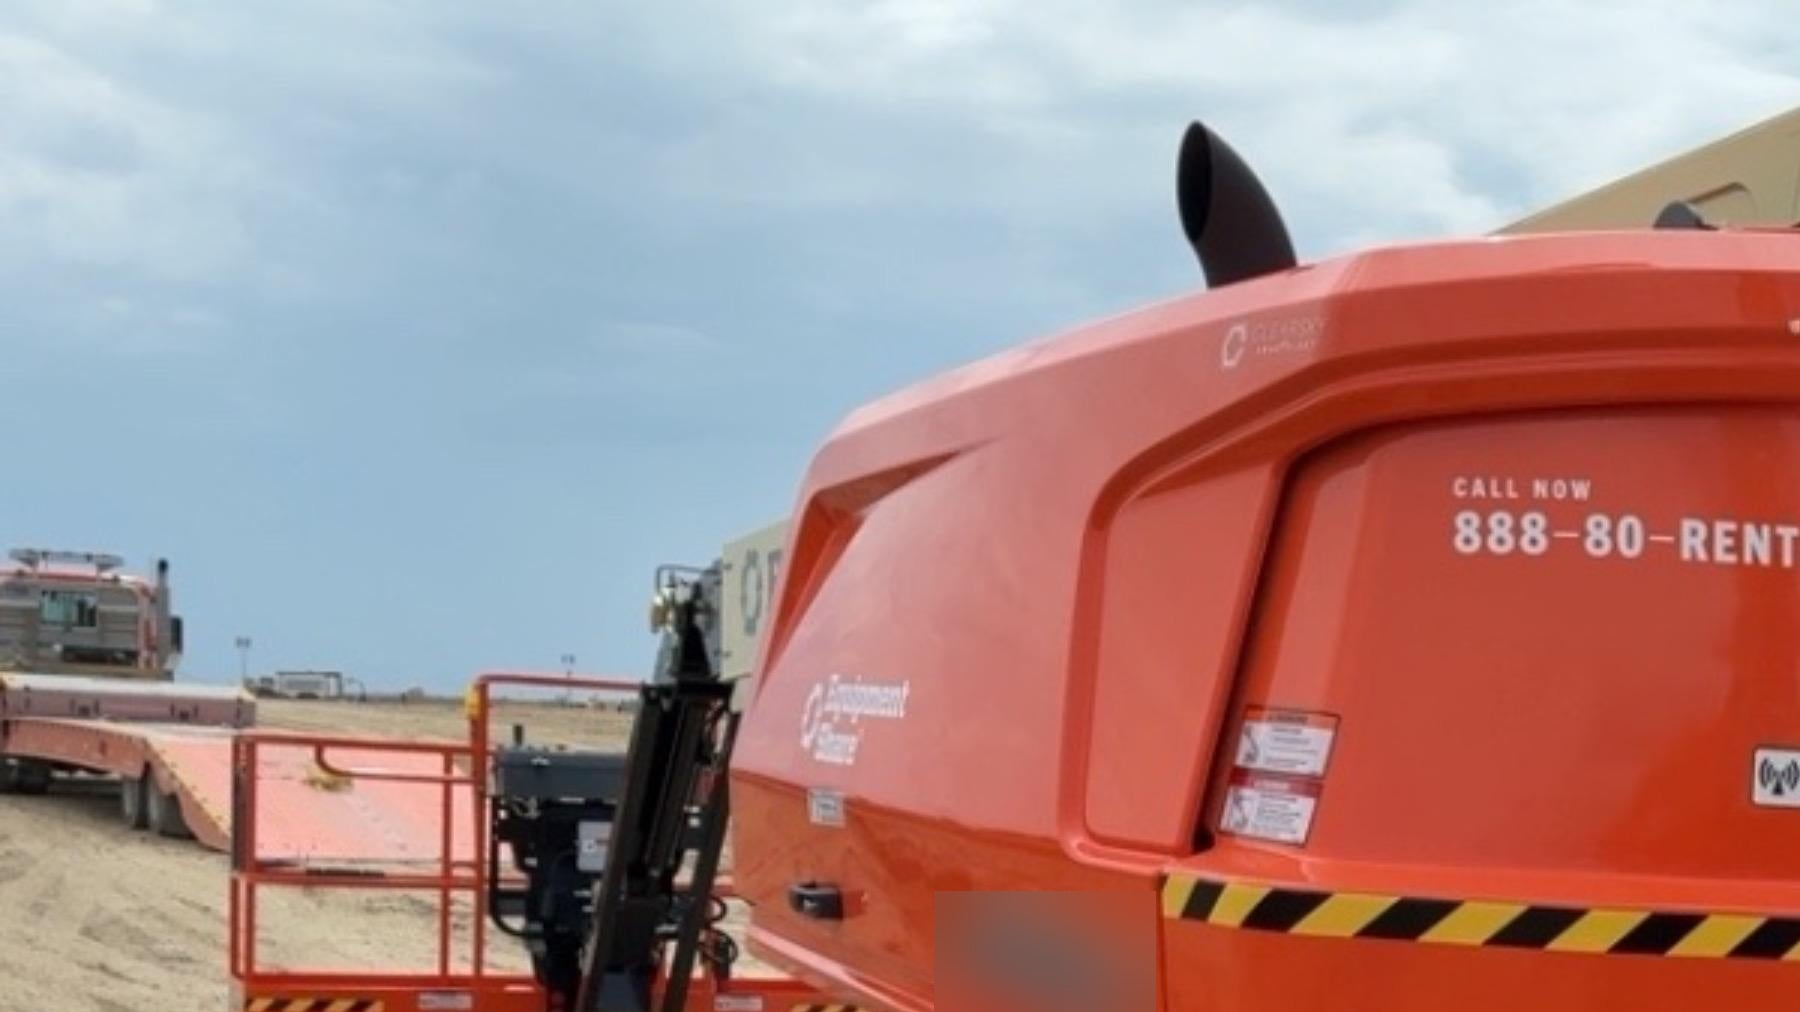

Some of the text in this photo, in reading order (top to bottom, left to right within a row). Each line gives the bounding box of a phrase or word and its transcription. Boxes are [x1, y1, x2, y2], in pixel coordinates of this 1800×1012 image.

[1453, 476, 1592, 500] CALL NOW
[824, 674, 911, 723] Equipment
[814, 723, 862, 766] Share
